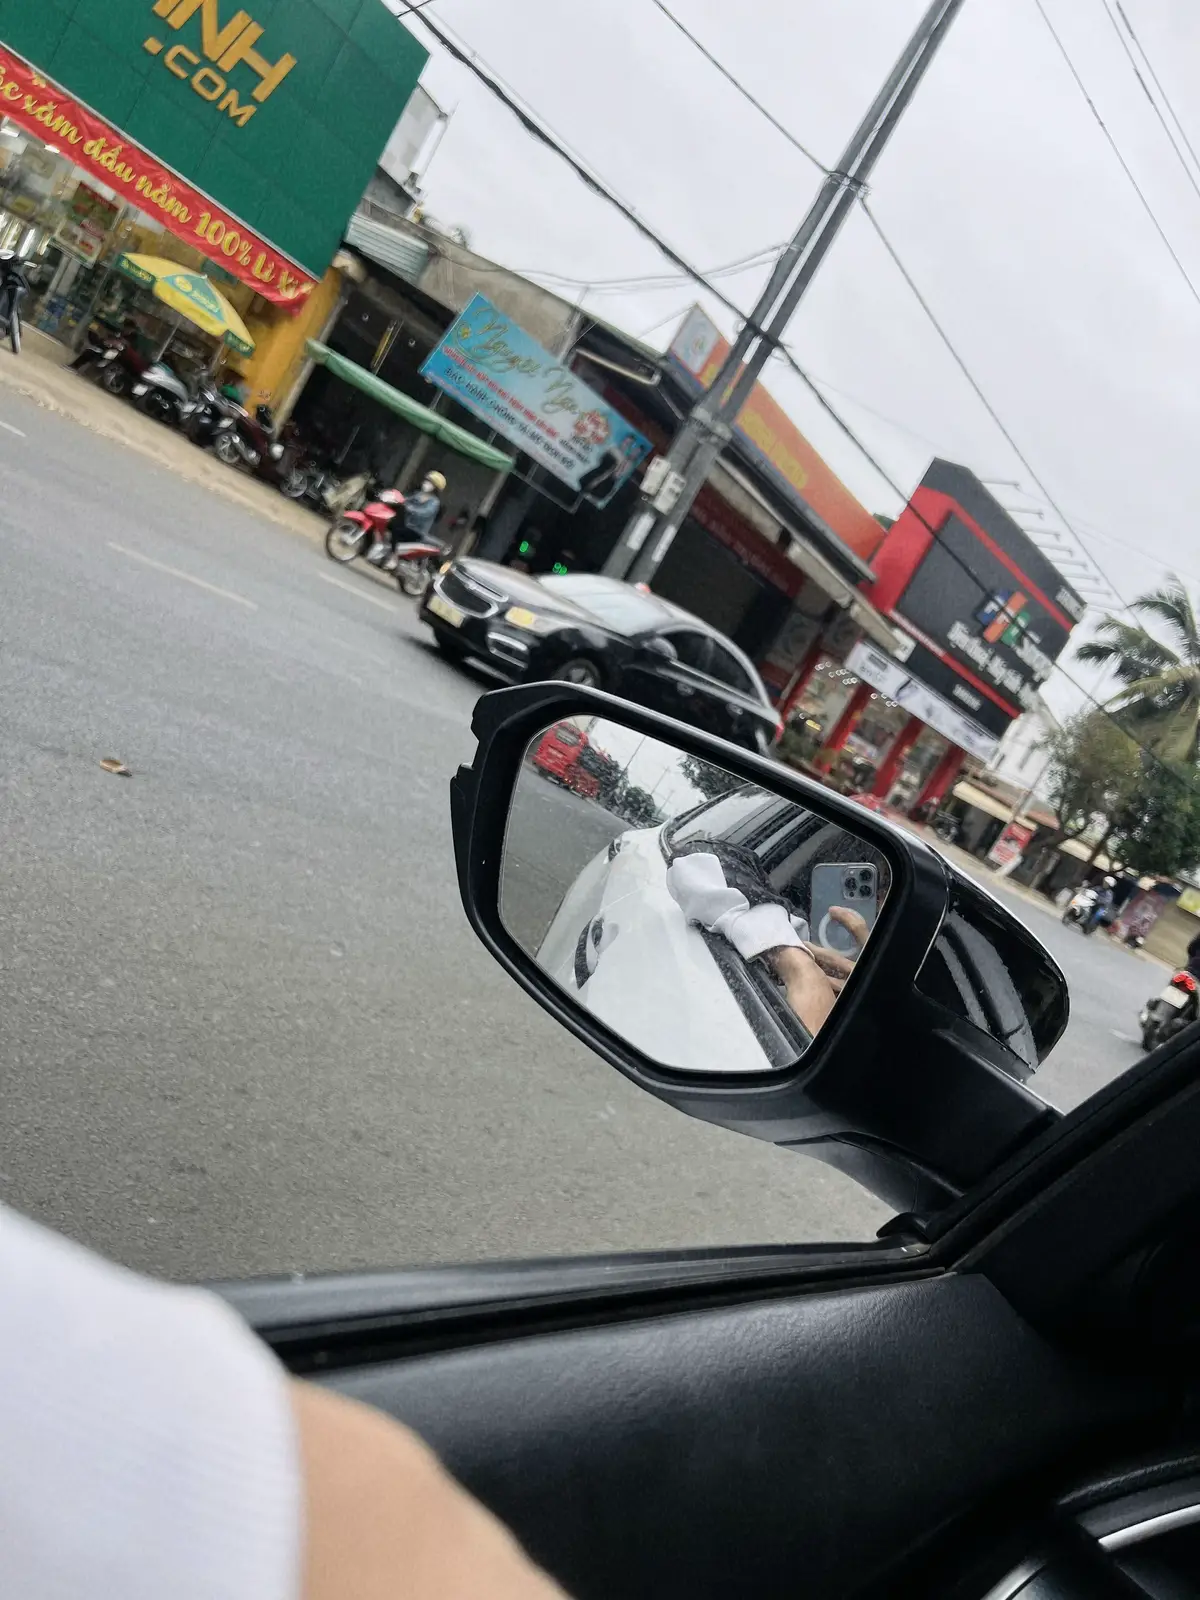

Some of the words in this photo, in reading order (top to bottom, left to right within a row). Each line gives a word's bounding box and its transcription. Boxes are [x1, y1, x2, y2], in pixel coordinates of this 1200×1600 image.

[143, 36, 257, 128] .COM
[135, 175, 192, 225] năm
[197, 212, 253, 267] 100%
